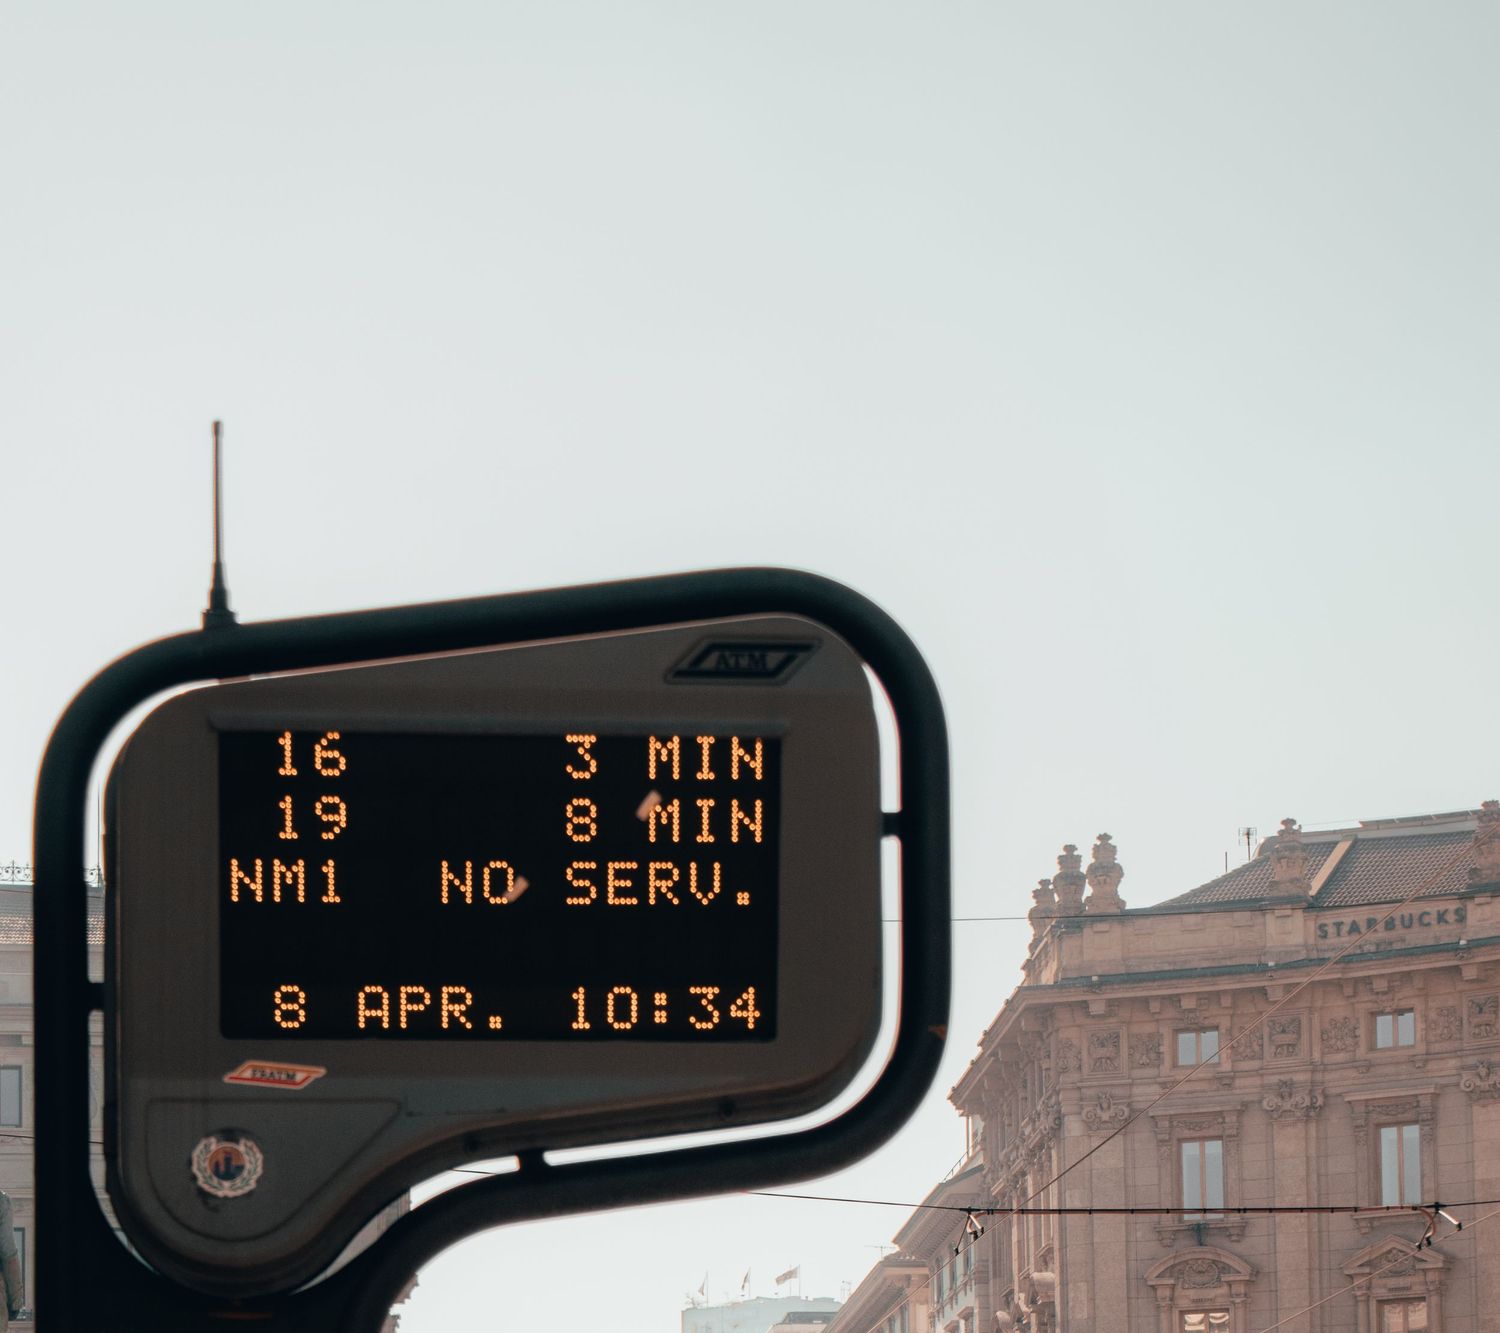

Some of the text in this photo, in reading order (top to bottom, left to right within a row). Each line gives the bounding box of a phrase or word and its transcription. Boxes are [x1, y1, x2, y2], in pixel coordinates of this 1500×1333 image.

[716, 652, 768, 671] ATM
[278, 731, 763, 780] 16 3 MIN
[278, 795, 763, 843] 19 8 MIN
[231, 858, 750, 905] NM1 NO SERV.
[1318, 907, 1465, 939] STARBUCKS
[274, 985, 760, 1029] 8 APR. 10:34
